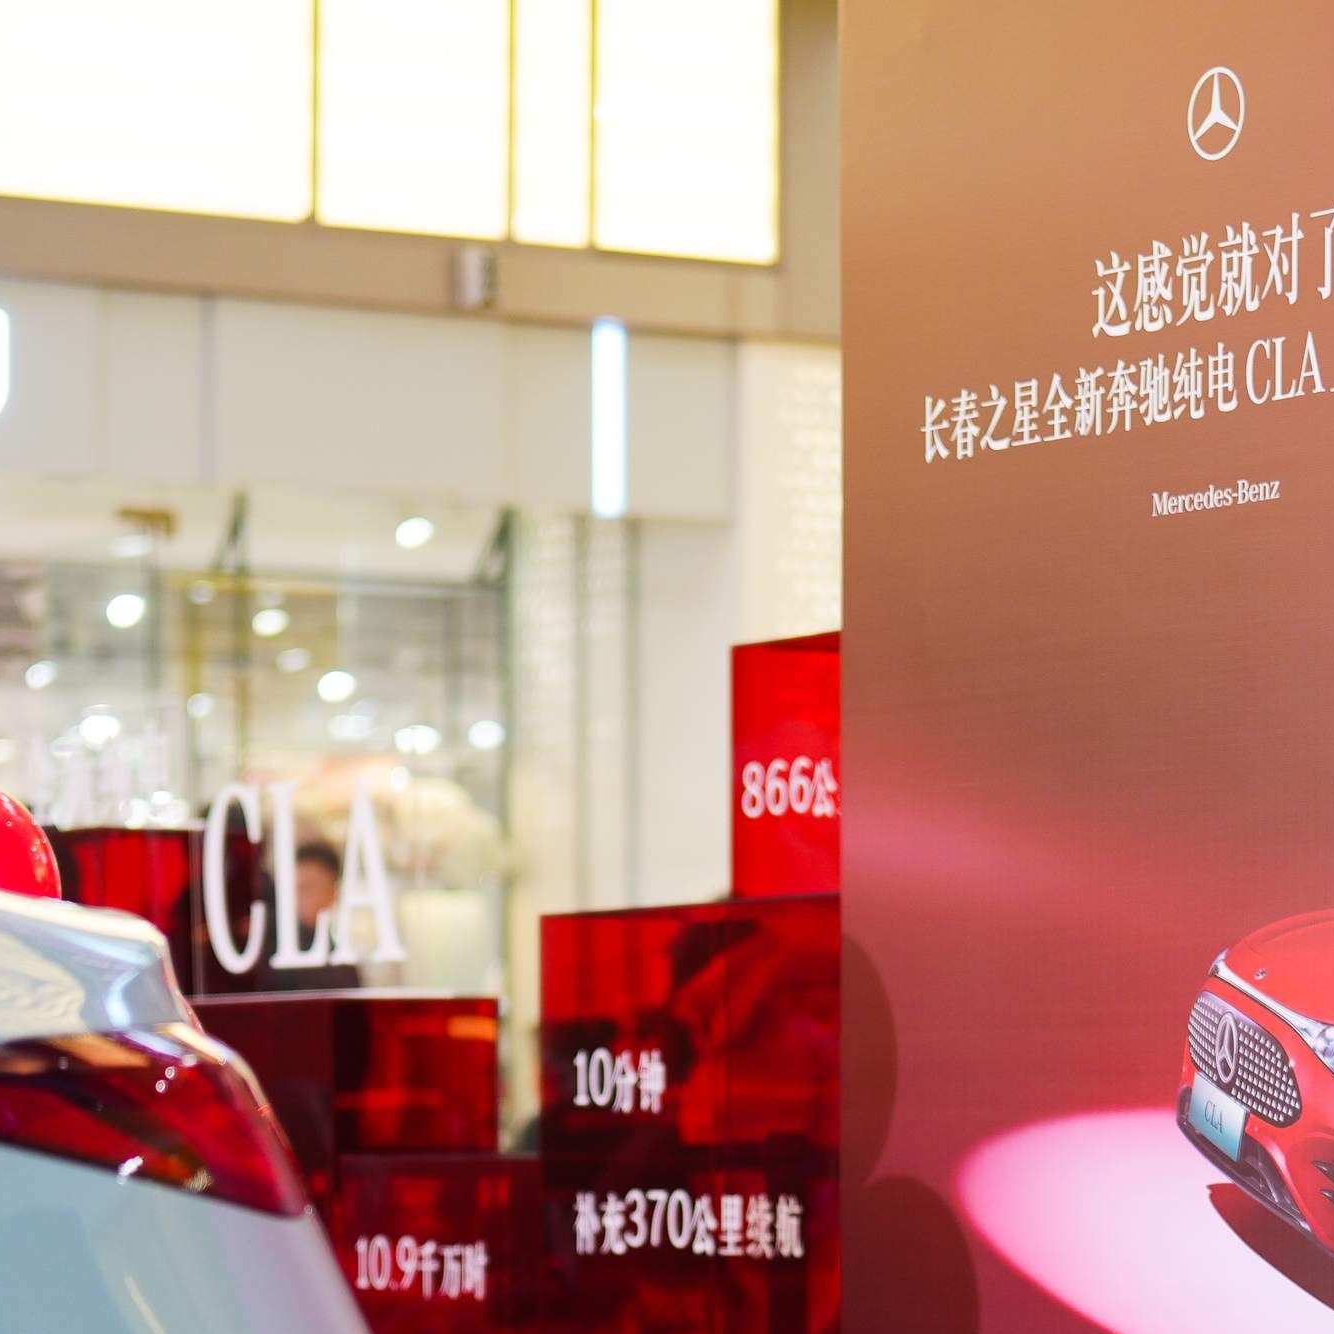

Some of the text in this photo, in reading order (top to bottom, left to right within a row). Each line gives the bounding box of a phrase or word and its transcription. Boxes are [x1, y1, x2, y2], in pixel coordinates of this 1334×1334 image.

[1151, 479, 1280, 517] Mercedes-Benz
[741, 755, 842, 818] 866公
[203, 779, 406, 974] CLA
[573, 1047, 666, 1114] 10分钟
[574, 1188, 804, 1259] 补充370公里续航
